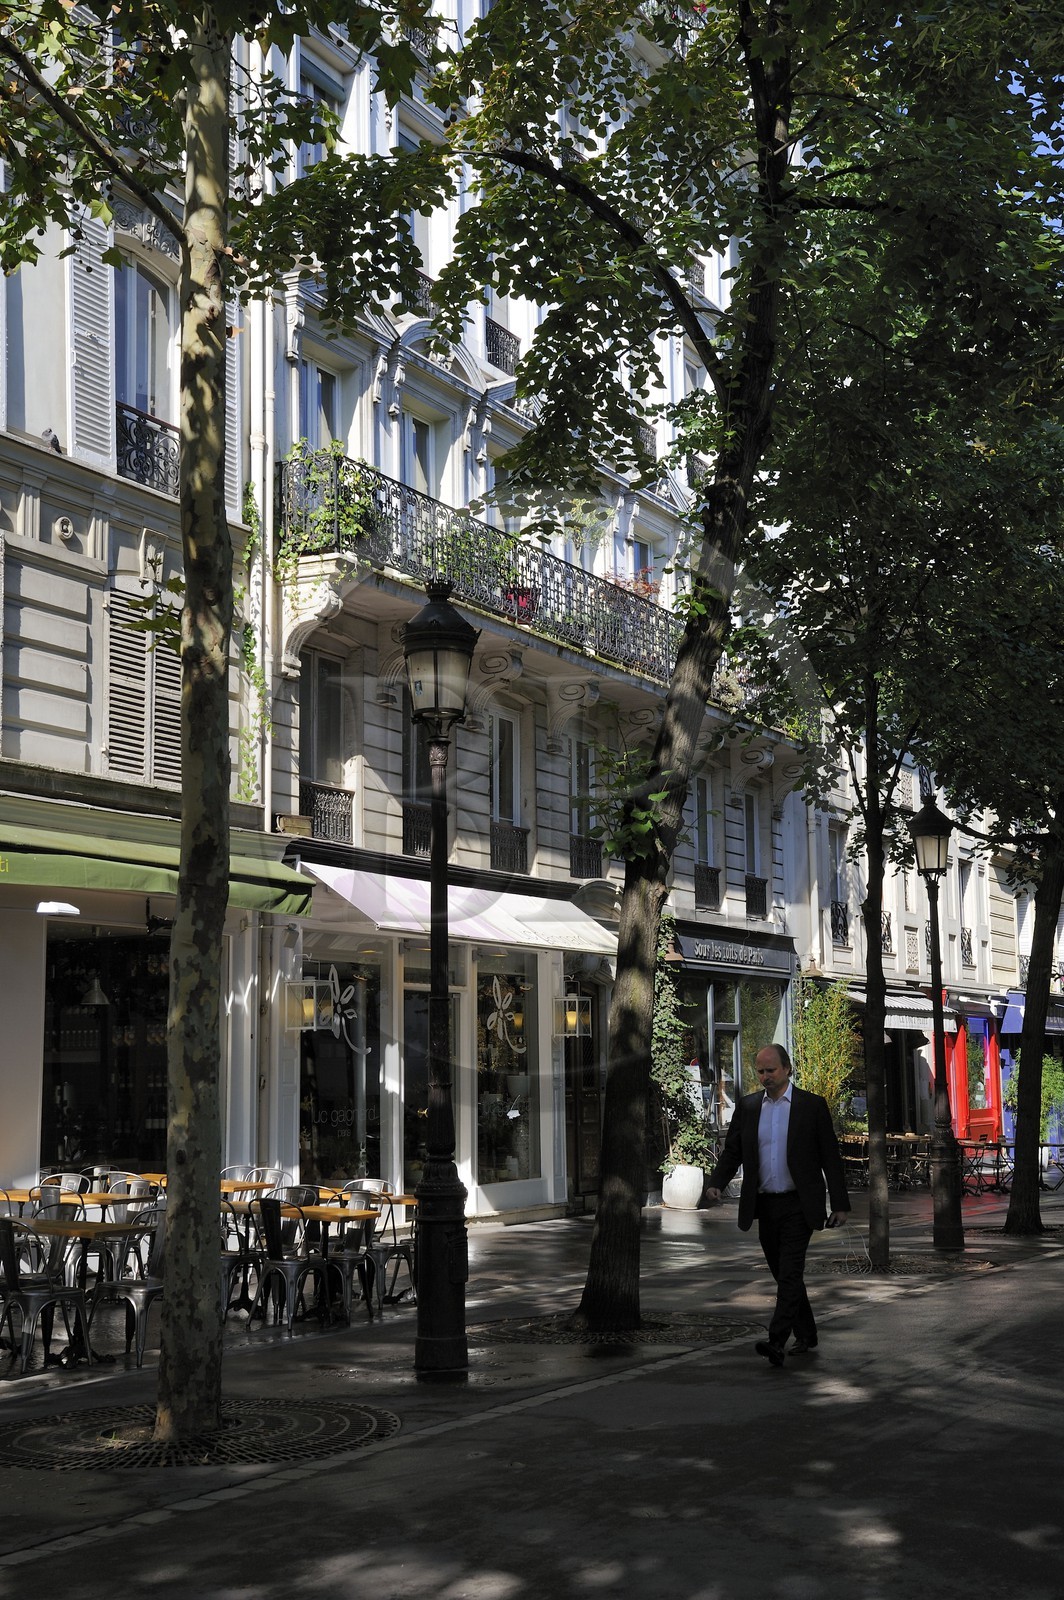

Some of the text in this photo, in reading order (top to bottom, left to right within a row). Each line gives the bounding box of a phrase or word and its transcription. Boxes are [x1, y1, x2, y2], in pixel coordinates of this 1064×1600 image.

[694, 942, 711, 957] Sous
[712, 942, 722, 958] les
[739, 945, 748, 962] de
[748, 947, 763, 964] Paris
